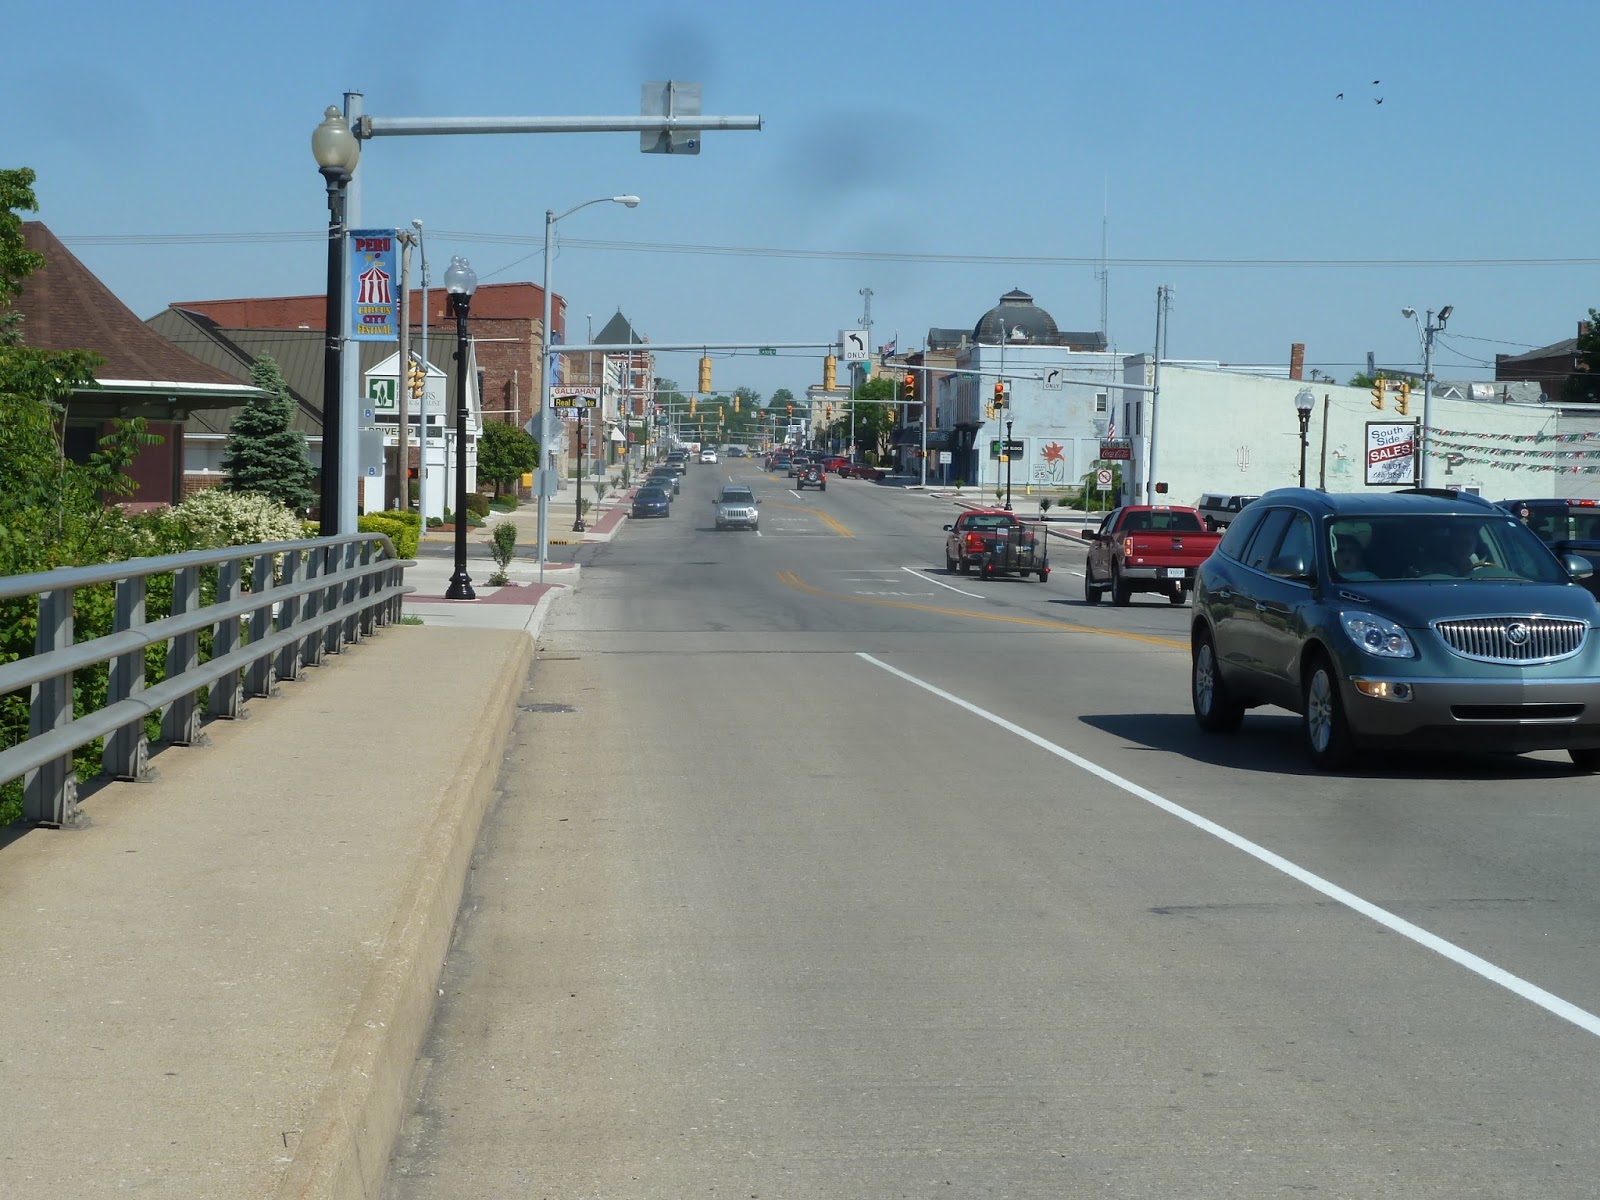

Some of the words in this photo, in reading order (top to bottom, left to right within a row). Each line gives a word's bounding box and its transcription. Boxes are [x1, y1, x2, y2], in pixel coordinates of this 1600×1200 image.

[355, 238, 391, 252] PERU
[358, 305, 391, 315] CIRCUS
[362, 314, 387, 324] CITY
[357, 324, 392, 335] FESTIVAL
[555, 398, 571, 407] Real
[572, 398, 595, 407] Ete
[365, 409, 371, 418] 8
[1371, 426, 1404, 439] South
[1376, 435, 1400, 446] Side
[1370, 444, 1411, 461] SALES
[368, 467, 375, 476] 8
